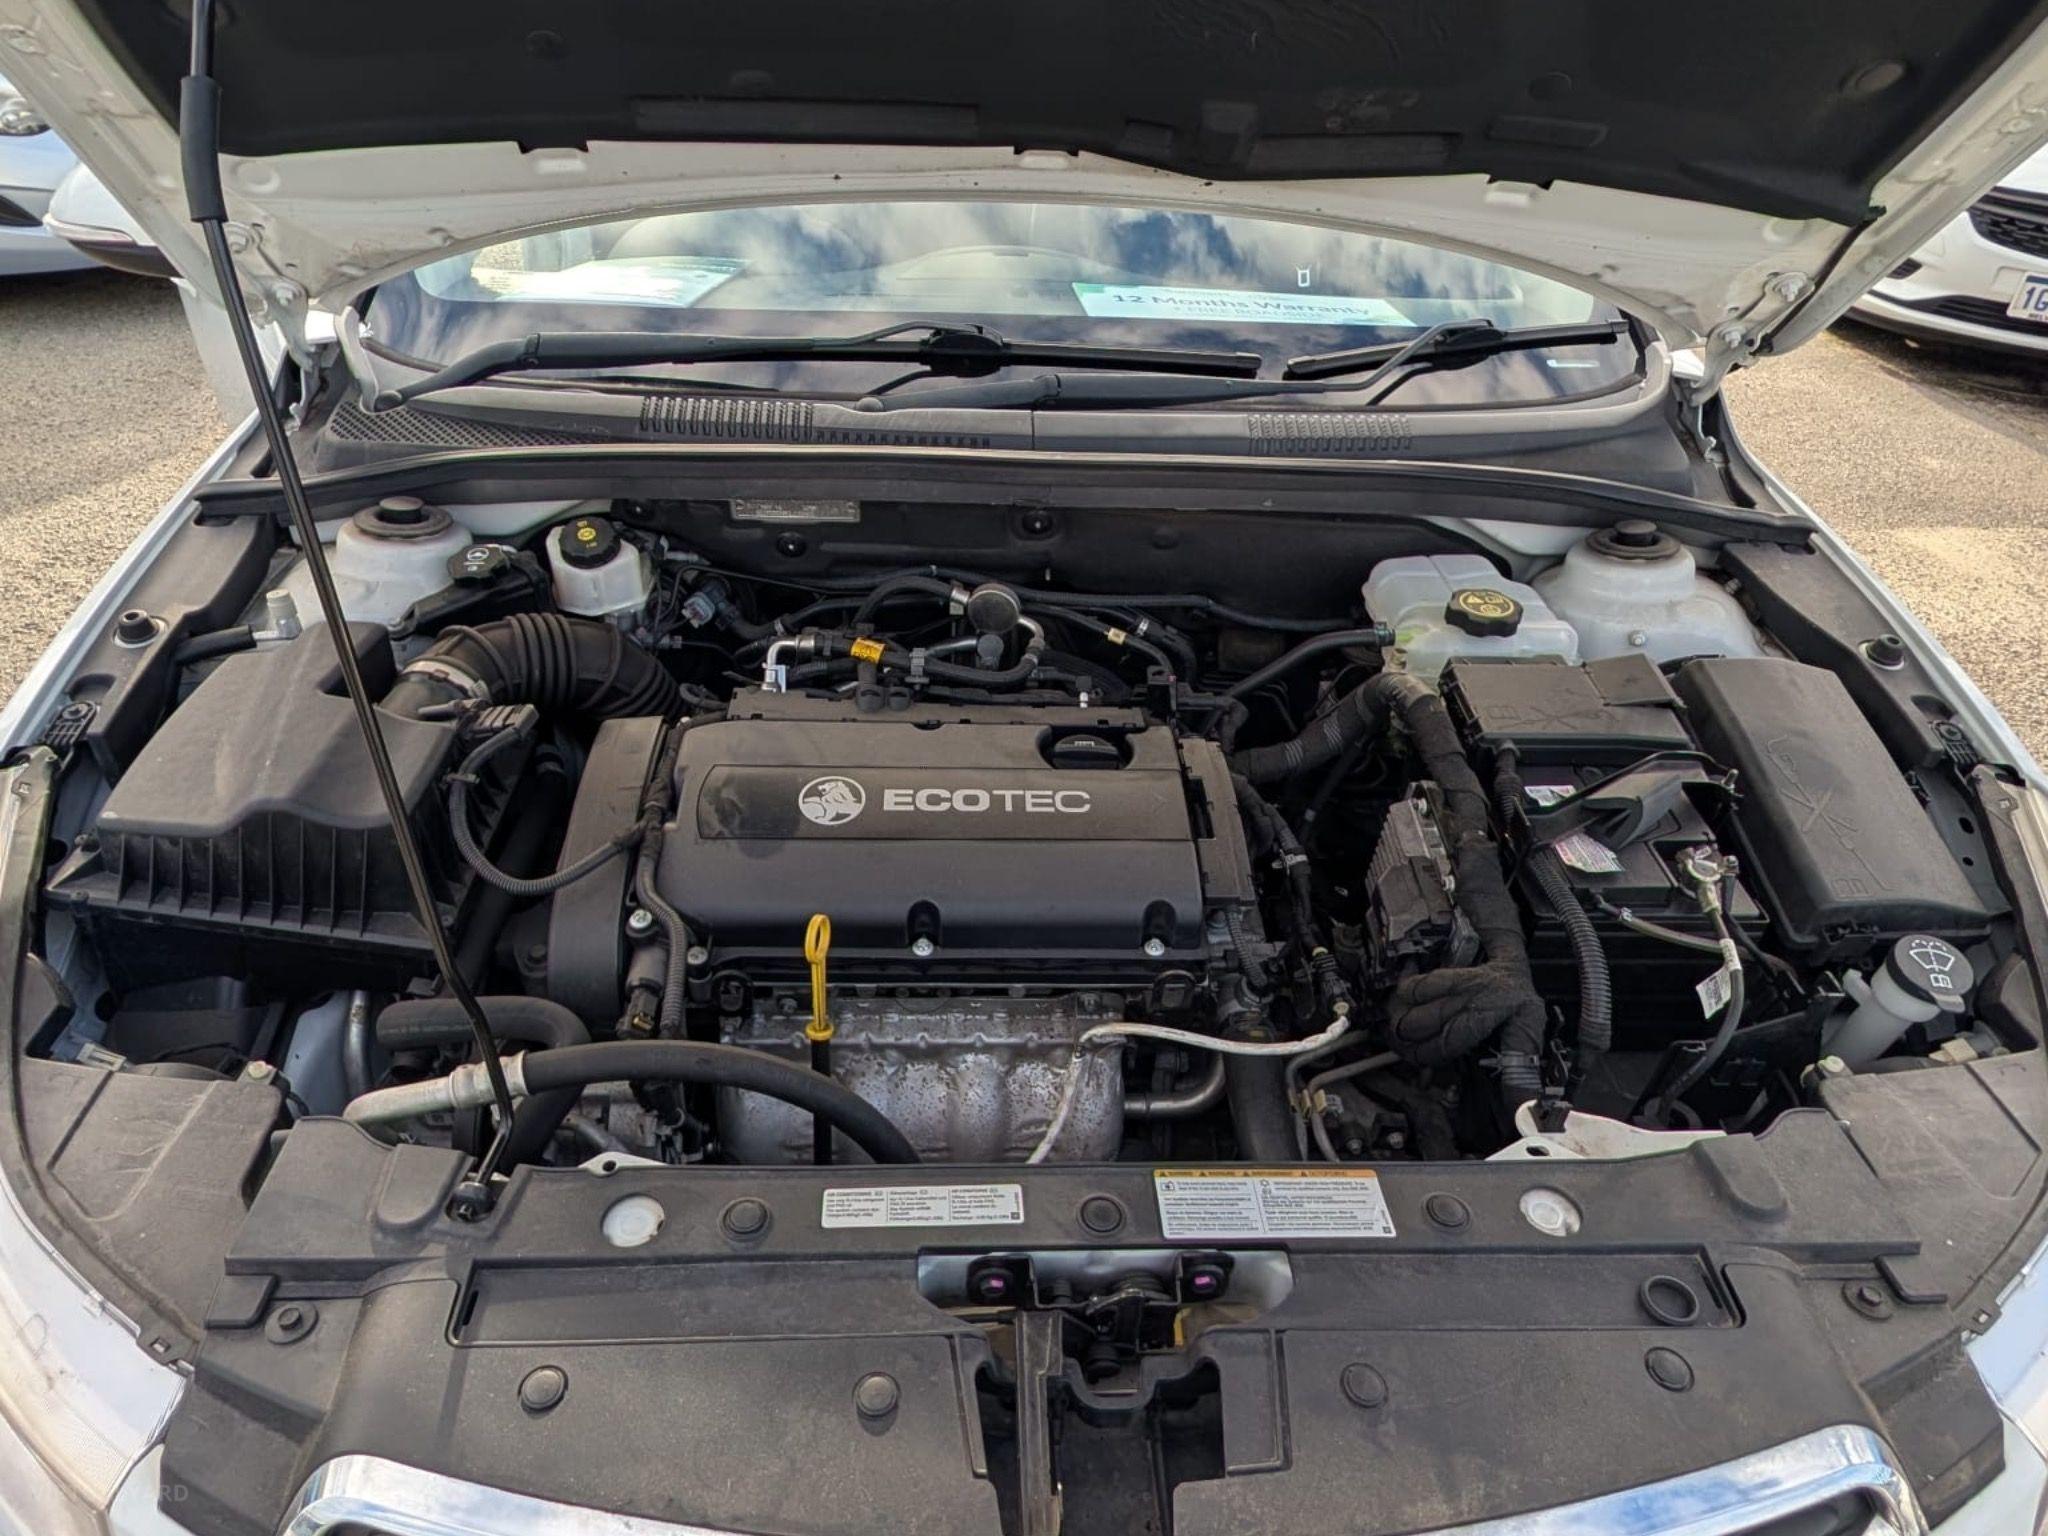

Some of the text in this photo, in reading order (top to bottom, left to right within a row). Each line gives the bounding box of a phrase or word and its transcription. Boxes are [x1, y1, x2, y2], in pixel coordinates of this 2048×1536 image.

[1112, 294, 1146, 304] 12
[1151, 295, 1249, 308] Months
[1253, 301, 1370, 316] Warranty
[883, 788, 1091, 813] ECOTEC
